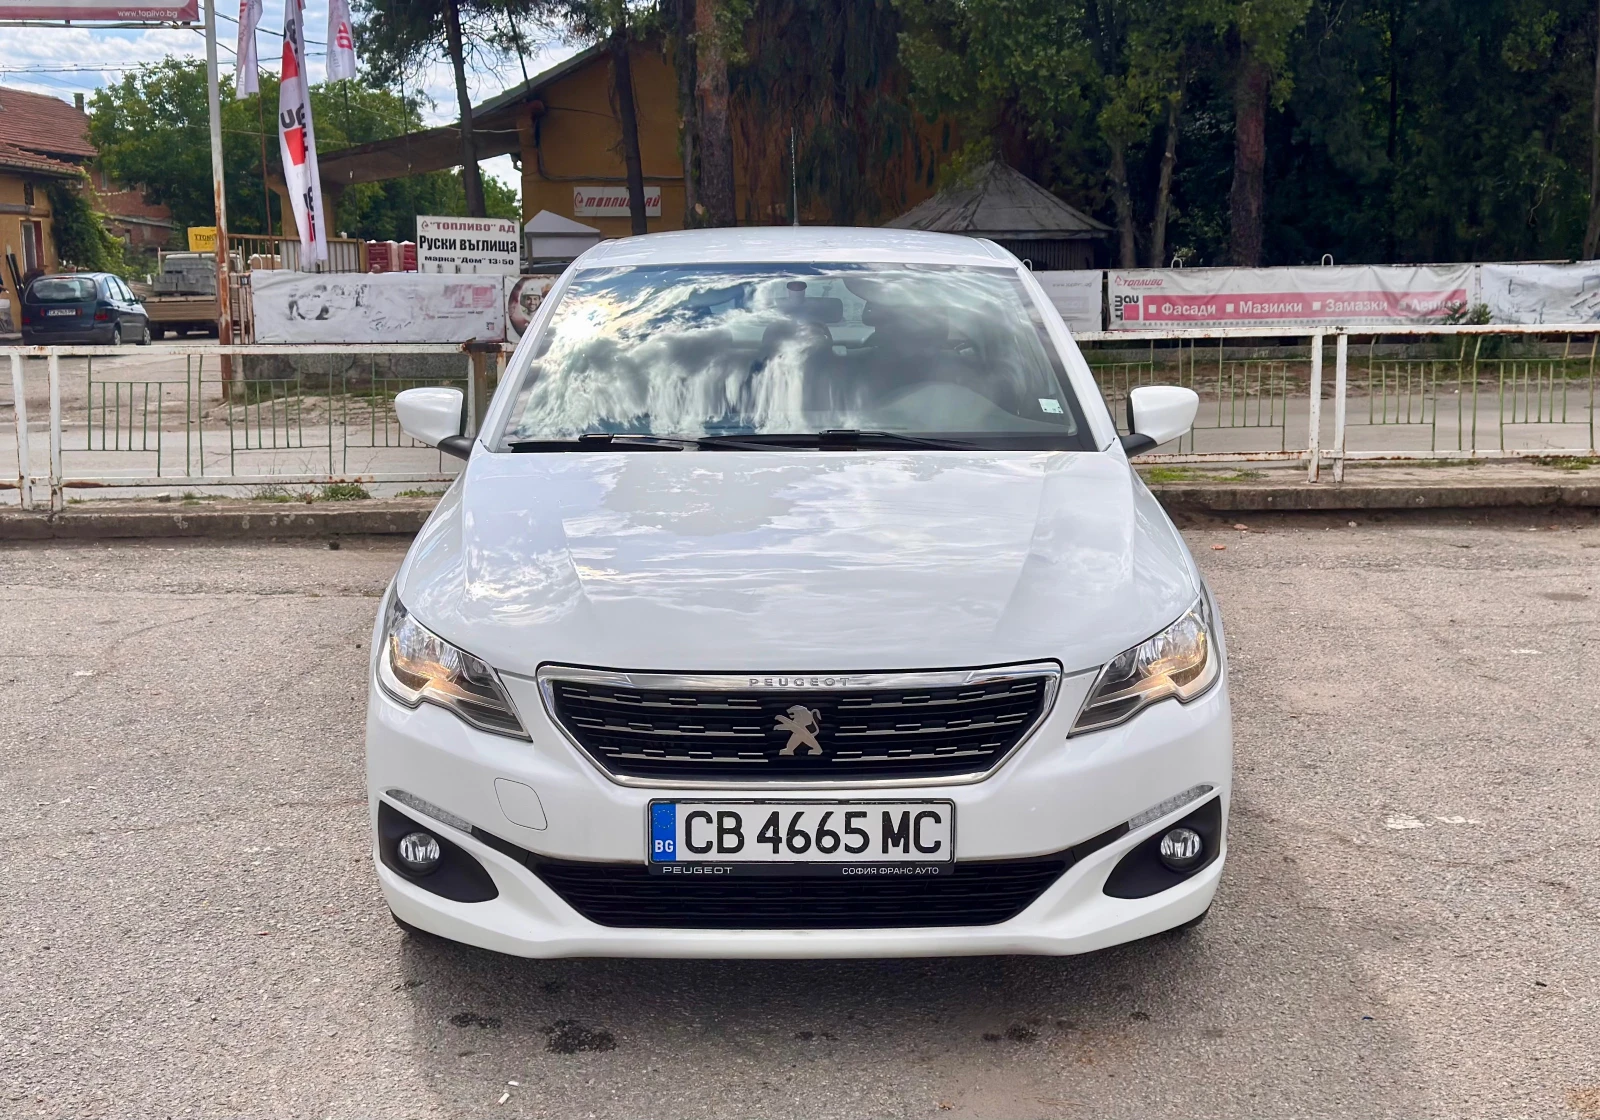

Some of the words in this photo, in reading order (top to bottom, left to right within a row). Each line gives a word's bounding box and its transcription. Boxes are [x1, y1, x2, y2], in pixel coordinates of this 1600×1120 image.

[117, 9, 178, 18] www.toplivo.bg
[498, 224, 516, 234] АД
[419, 235, 457, 251] Руски
[459, 239, 518, 254] въглища
[424, 255, 456, 263] марка
[1161, 302, 1217, 316] Фасади
[1239, 301, 1303, 314] Мазилки
[1325, 298, 1388, 312] Замазки
[749, 677, 850, 687] PEUGEOT
[654, 839, 674, 853] BG
[684, 810, 745, 854] CB
[756, 810, 870, 854] 4665
[881, 810, 942, 854] MC
[662, 866, 734, 875] PEUGEOT
[842, 867, 877, 876] СОФИЯ
[879, 867, 913, 876] ФРАНС
[915, 866, 940, 875] АУТО
